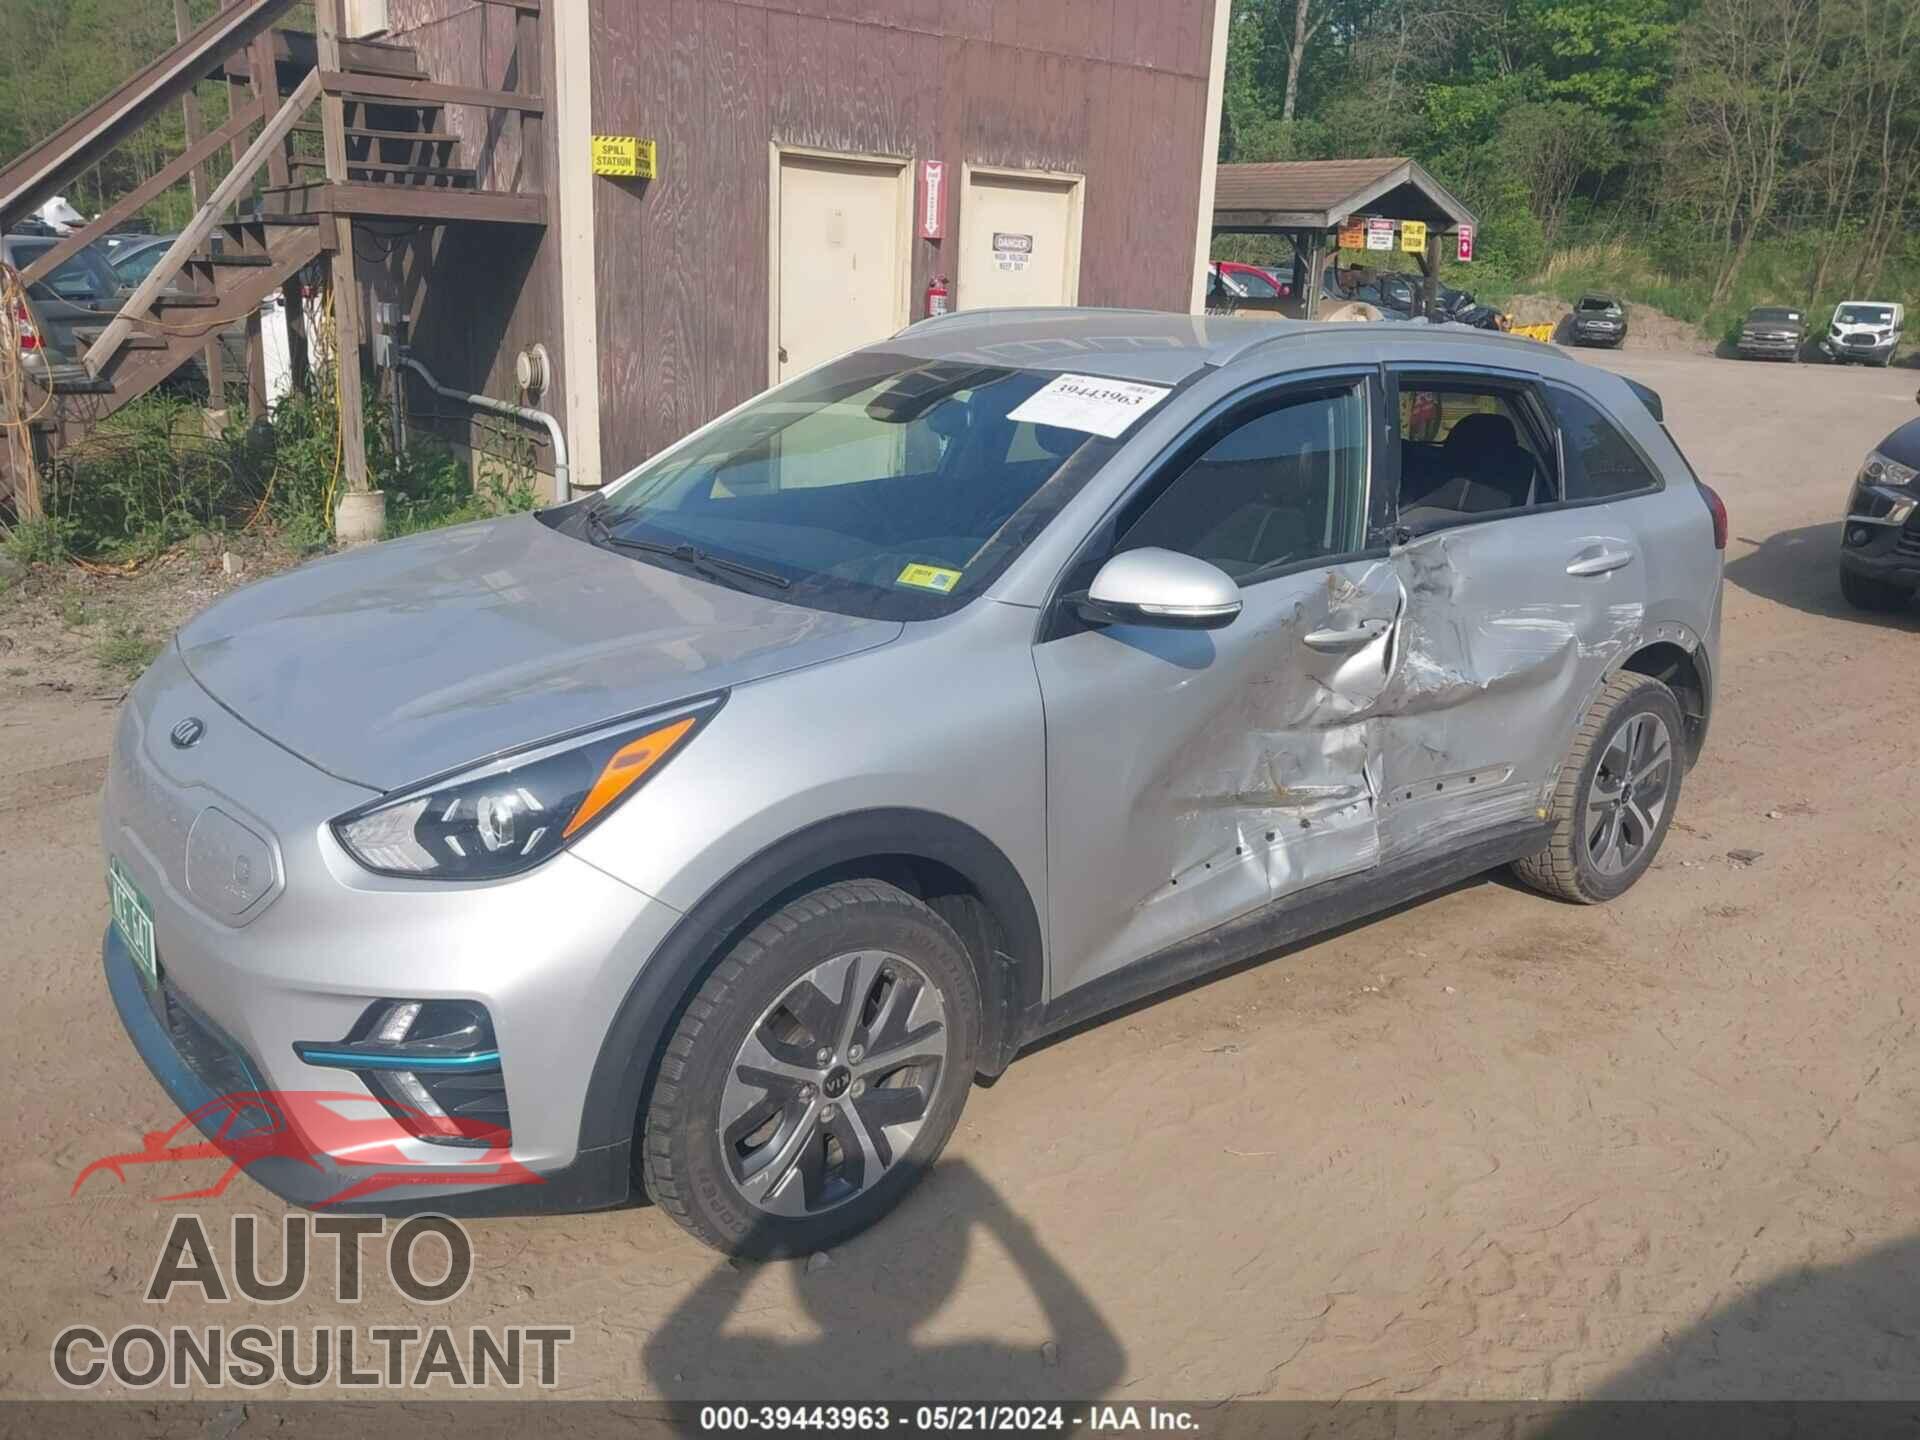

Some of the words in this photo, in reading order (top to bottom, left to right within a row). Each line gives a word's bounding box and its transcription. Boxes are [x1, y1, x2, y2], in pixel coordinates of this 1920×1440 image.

[602, 145, 624, 155] SPILL
[596, 156, 631, 167] STATION
[1053, 384, 1144, 406] 39443963
[826, 1073, 849, 1092] KIA
